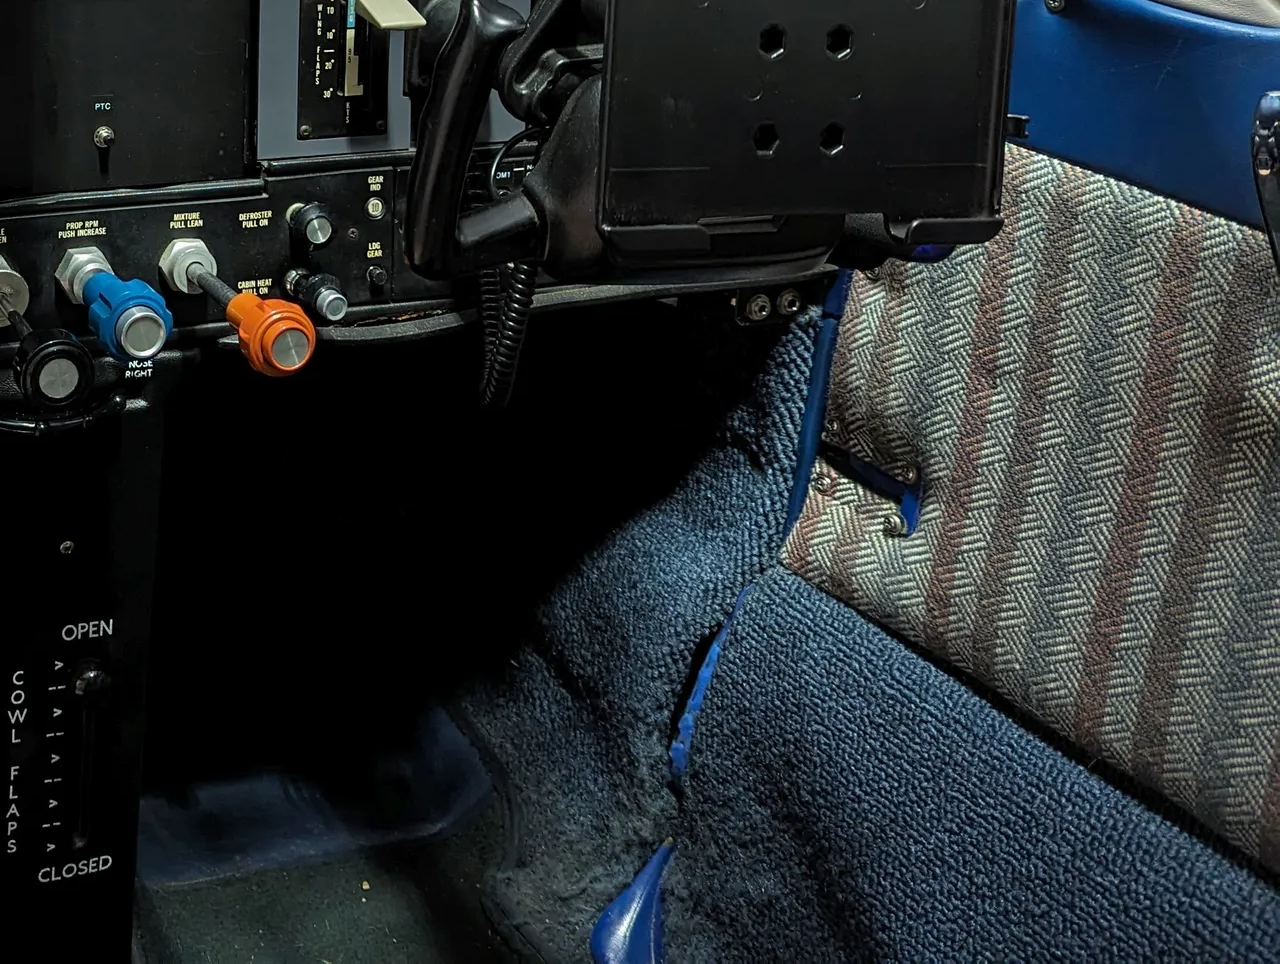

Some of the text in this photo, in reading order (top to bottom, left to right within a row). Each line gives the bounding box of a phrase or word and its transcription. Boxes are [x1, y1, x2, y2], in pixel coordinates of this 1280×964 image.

[327, 6, 334, 14] TO
[368, 176, 383, 184] GEAR
[370, 183, 381, 191] IND
[173, 212, 201, 221] MIXTURE
[239, 211, 272, 221] DEFROSTER
[66, 220, 99, 230] PROP RPM
[170, 219, 203, 229] PULL LEAN
[242, 220, 258, 228] PULL
[58, 227, 107, 238] PUSH INCREASE
[368, 242, 381, 250] LDG
[367, 249, 383, 258] GEAR
[238, 279, 272, 289] CABIN HEAT
[125, 368, 153, 379] RIGHT
[62, 619, 113, 641] OPEN
[8, 670, 27, 744] COWL
[6, 766, 20, 853] FLAPS
[38, 854, 113, 883] CLOSED
